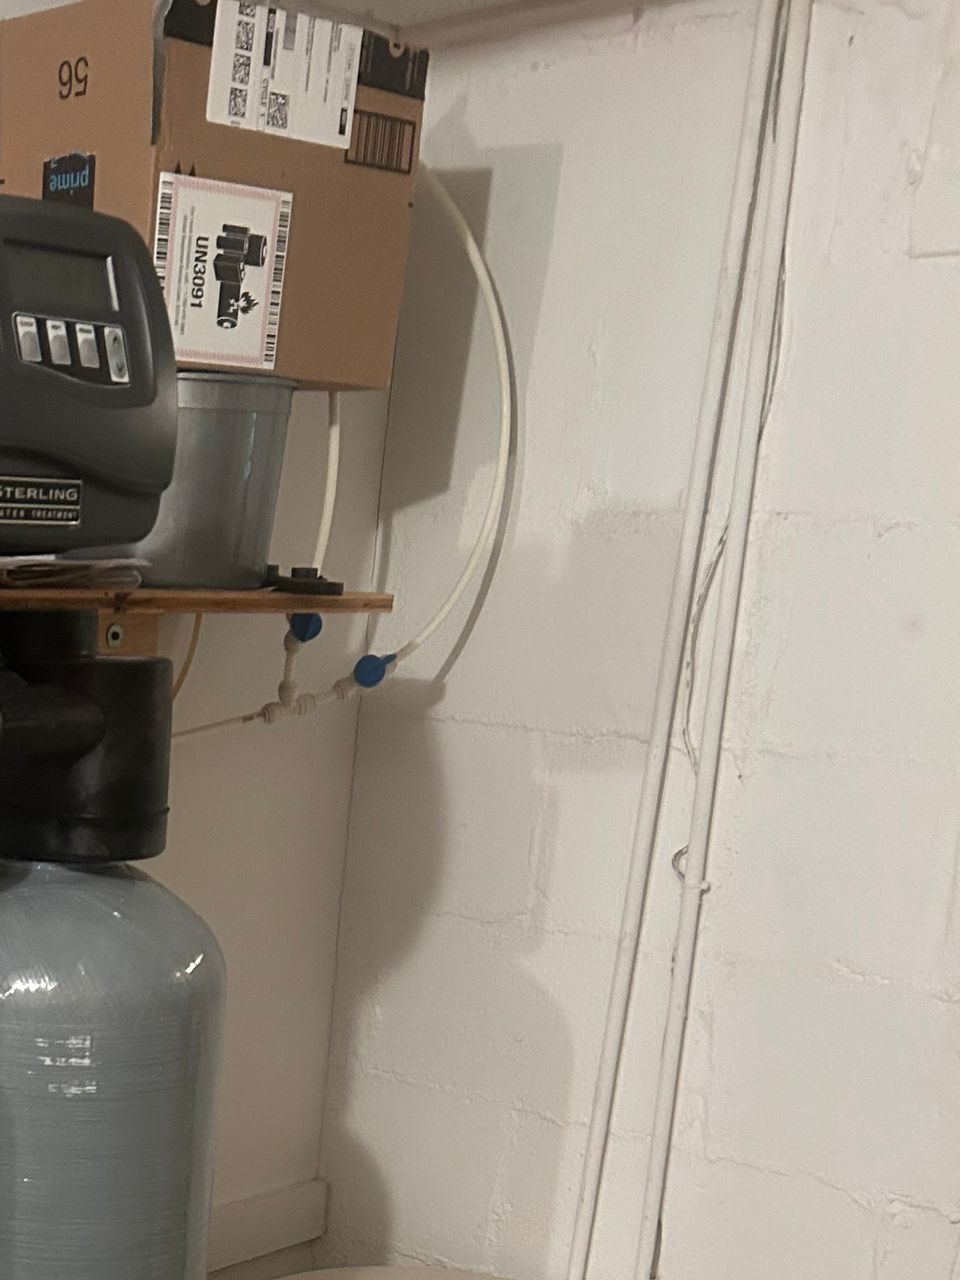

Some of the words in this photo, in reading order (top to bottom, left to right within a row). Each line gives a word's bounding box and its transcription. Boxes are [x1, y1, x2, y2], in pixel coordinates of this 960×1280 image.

[59, 56, 88, 99] 56
[50, 163, 89, 195] prime
[190, 235, 209, 309] UN3091
[31, 509, 77, 519] TREATMENT
